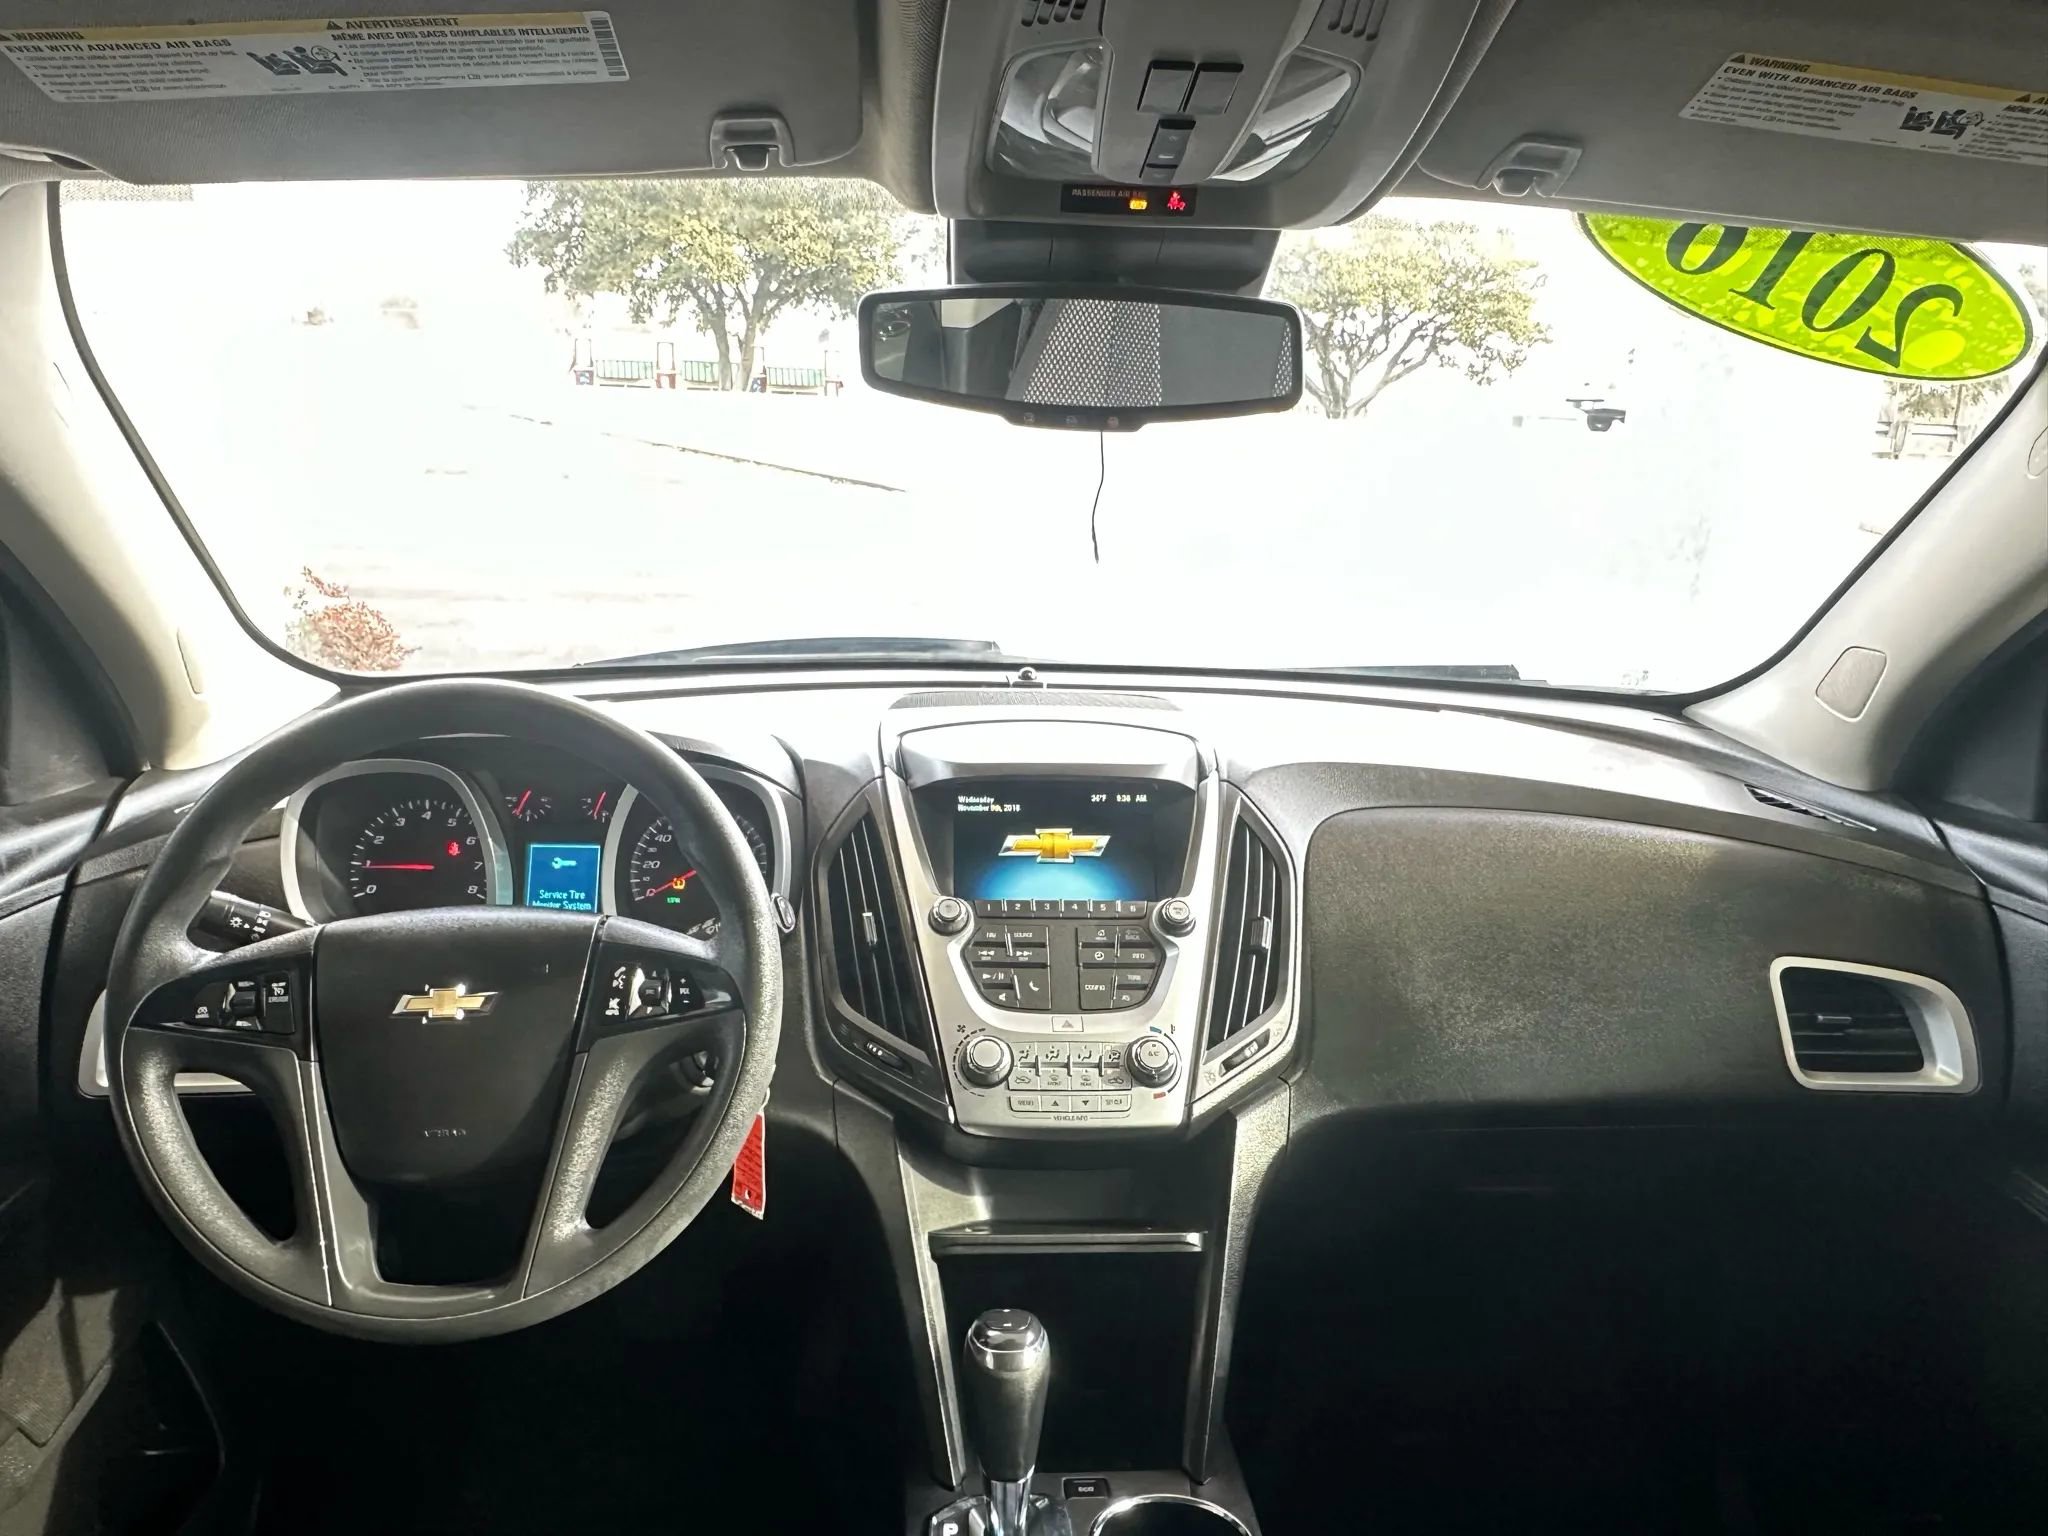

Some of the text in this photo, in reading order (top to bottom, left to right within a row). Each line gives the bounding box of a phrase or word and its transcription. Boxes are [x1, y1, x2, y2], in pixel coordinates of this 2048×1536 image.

[345, 17, 459, 29] AVERTISSEMENT
[12, 31, 84, 41] WARNING
[367, 30, 395, 40] AVEC
[419, 29, 448, 39] SACS
[518, 26, 590, 37] INTELLIGENTS
[5, 38, 232, 53] EVEN WITH ADVANCED AIR BAGS
[1749, 56, 1811, 73] WARNING
[1723, 66, 1757, 77] EVEN
[1758, 70, 1791, 82] WITH
[1793, 75, 1857, 91] ADVANCED
[1859, 84, 1882, 94] AIR
[1882, 87, 1918, 99] BAGS
[421, 811, 432, 820] 4
[395, 817, 406, 827] 3
[447, 818, 457, 827] 5
[373, 835, 384, 845] 2
[466, 837, 477, 845] 6
[654, 834, 672, 843] 40
[474, 861, 483, 870] 7
[642, 860, 661, 869] 20
[366, 884, 377, 894] 0
[467, 885, 478, 894] 8
[540, 889, 586, 899] Service Tire
[532, 900, 592, 911] Monitor System
[1014, 903, 1021, 911] 2
[1044, 903, 1050, 911] 3
[1072, 903, 1078, 911] 4
[1100, 903, 1107, 911] 5
[943, 1523, 959, 1536] P
